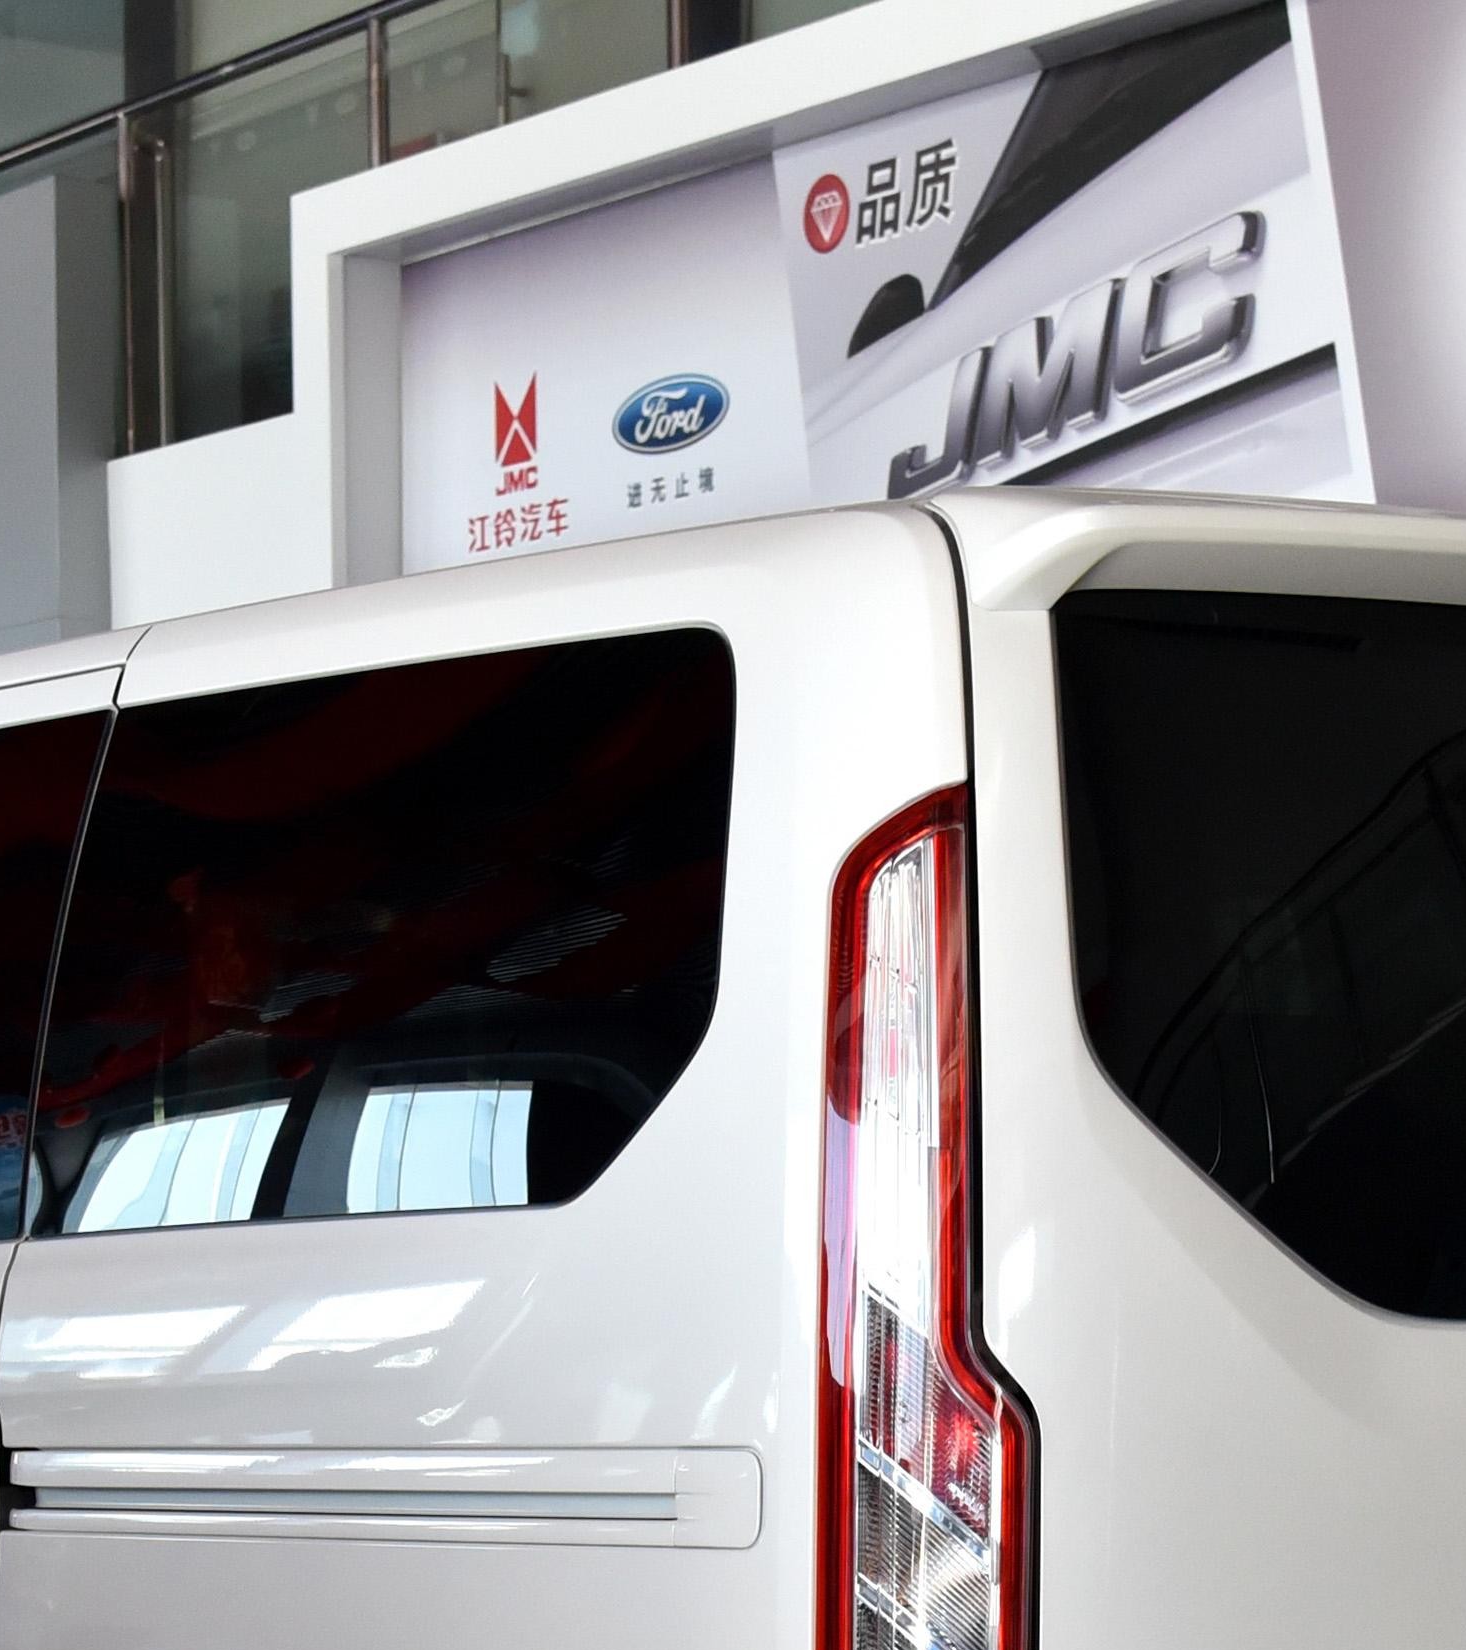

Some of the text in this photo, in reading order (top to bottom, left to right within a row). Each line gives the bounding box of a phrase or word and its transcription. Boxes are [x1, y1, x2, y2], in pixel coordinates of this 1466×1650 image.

[855, 139, 959, 247] 品质
[887, 209, 1267, 500] JMC
[634, 387, 706, 443] Ford
[495, 466, 538, 496] JMC
[627, 466, 715, 509] 进无止境
[468, 498, 570, 553] 江铃汽车
